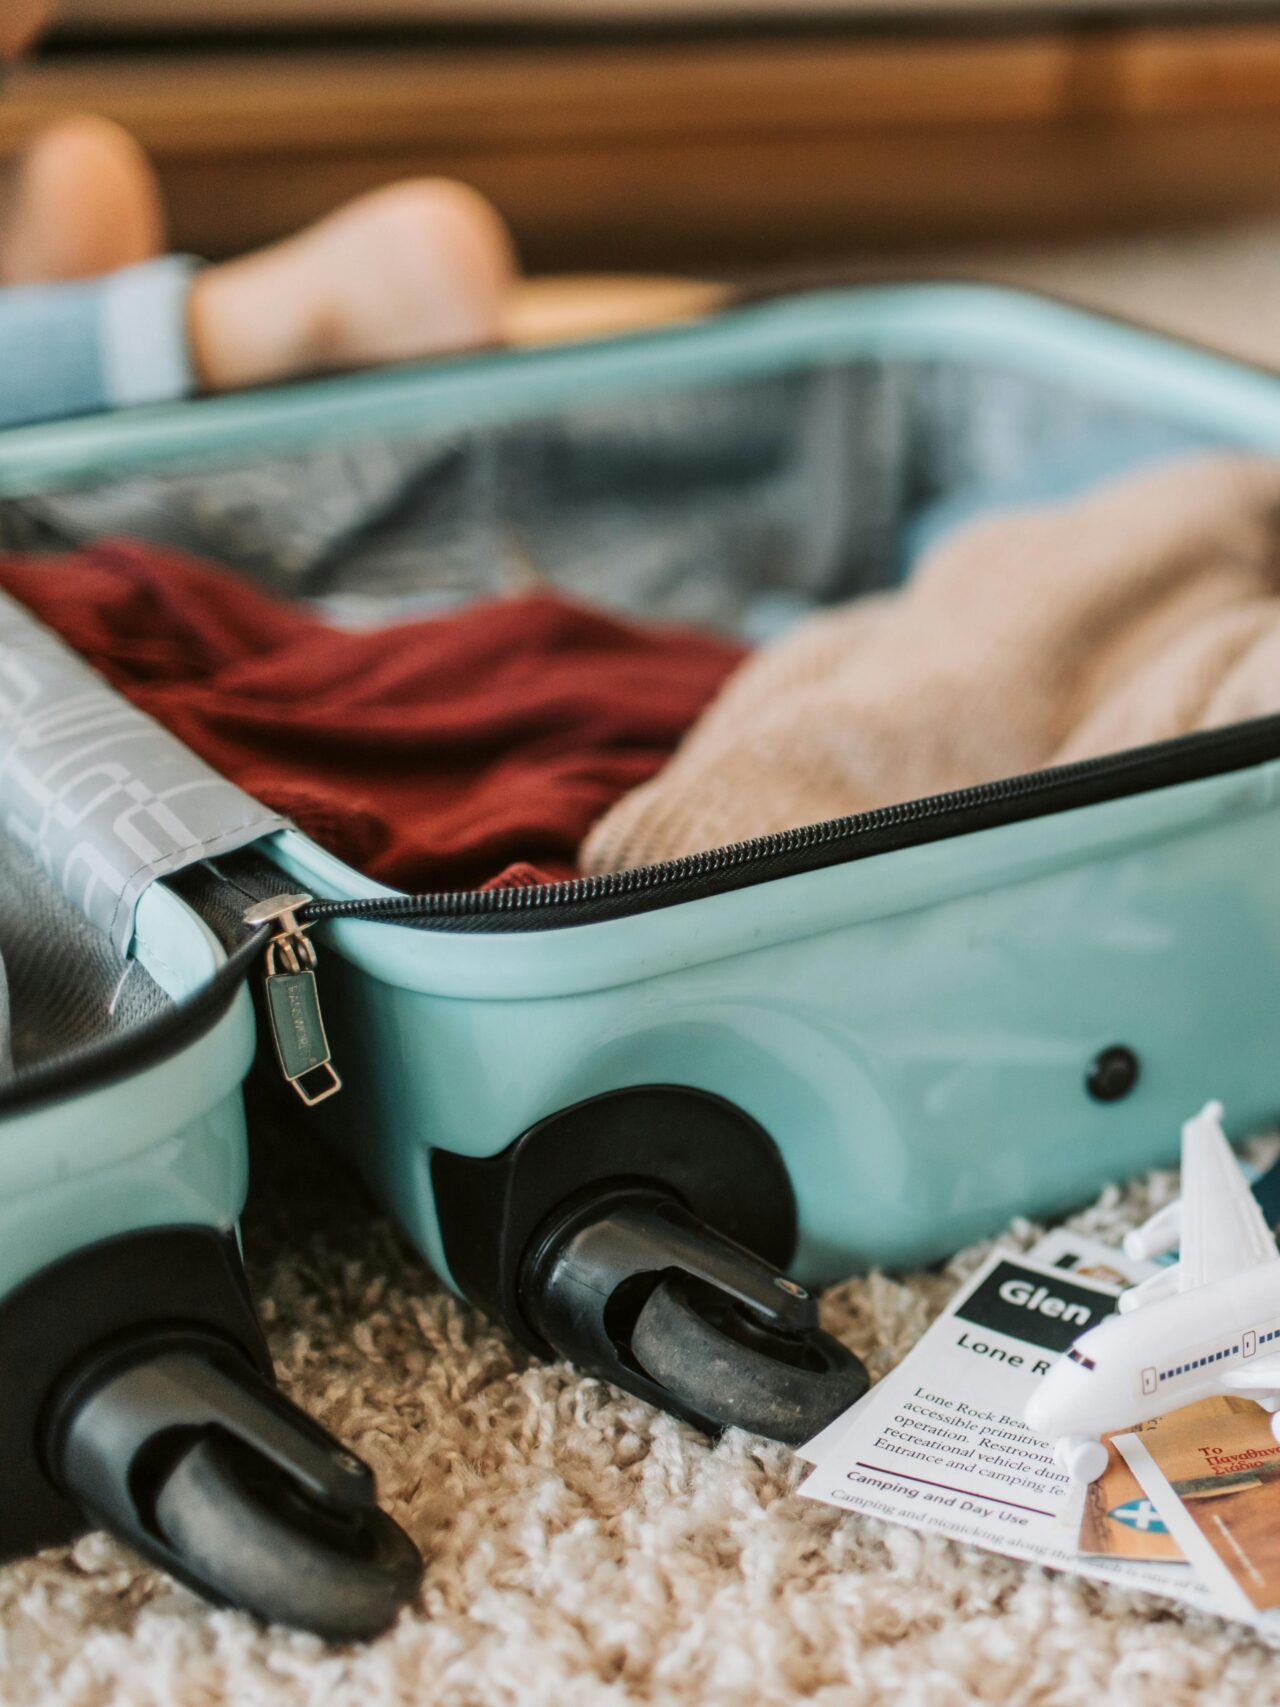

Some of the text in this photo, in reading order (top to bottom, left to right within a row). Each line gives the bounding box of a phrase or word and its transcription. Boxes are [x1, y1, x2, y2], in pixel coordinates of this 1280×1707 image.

[999, 1279, 1092, 1326] Glen
[957, 1333, 1052, 1376] Lone R
[903, 1400, 1050, 1449] accessible primitive
[914, 1387, 953, 1409] Lone
[956, 1402, 996, 1422] Rock
[894, 1414, 970, 1443] operation.
[873, 1437, 1066, 1497] Entrance and camping fe
[882, 1426, 1070, 1484] recreational vehicle dum
[1198, 1446, 1223, 1457] Το
[830, 1488, 896, 1516] Camping
[897, 1507, 926, 1522] and
[846, 1470, 1030, 1527] Camping and Day Use
